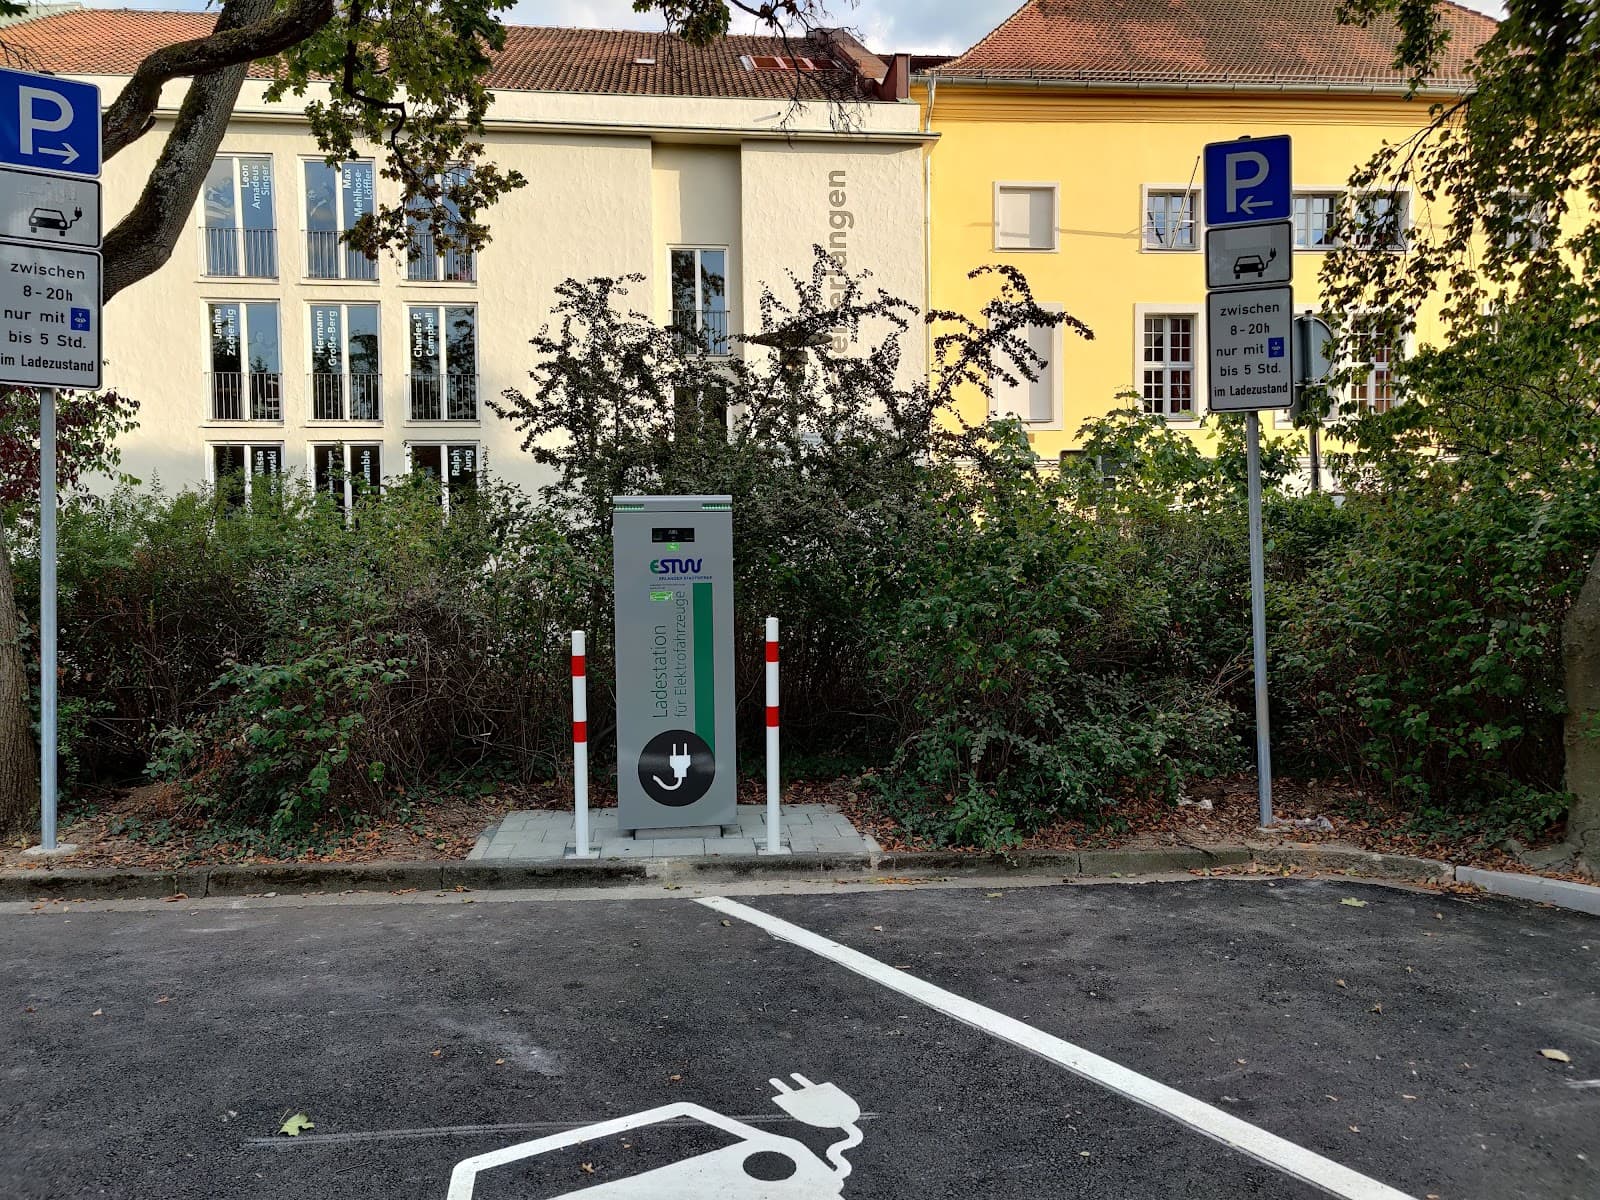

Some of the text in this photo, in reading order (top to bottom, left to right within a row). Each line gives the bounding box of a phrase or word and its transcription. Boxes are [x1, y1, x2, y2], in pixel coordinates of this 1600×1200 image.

[19, 85, 74, 155] P
[241, 164, 250, 188] Leon
[251, 165, 261, 209] Amadeus
[261, 165, 271, 196] Singer
[343, 168, 352, 189] Max
[363, 168, 373, 200] Löffler
[1226, 151, 1269, 213] P
[10, 262, 85, 280] zwischen
[4, 309, 65, 323] nur mit
[213, 308, 222, 339] Janina
[1220, 303, 1280, 316] zwischen
[8, 330, 86, 349] bis 5 Std.
[226, 308, 237, 356] Zschernig
[315, 310, 325, 354] Hermann
[327, 310, 338, 367] Große-Berg
[413, 322, 423, 358] Charles
[425, 312, 436, 357] Campbell
[0, 353, 94, 372] im Ladezustand
[1216, 343, 1264, 356] nur mit
[1220, 362, 1281, 376] bis 5 Std.
[1214, 382, 1288, 397] im Ladezustand
[450, 449, 462, 477] Ralph
[463, 449, 474, 473] Jung
[672, 591, 689, 717] für Elektrofahrzeuge
[650, 625, 668, 718] Ladestation
